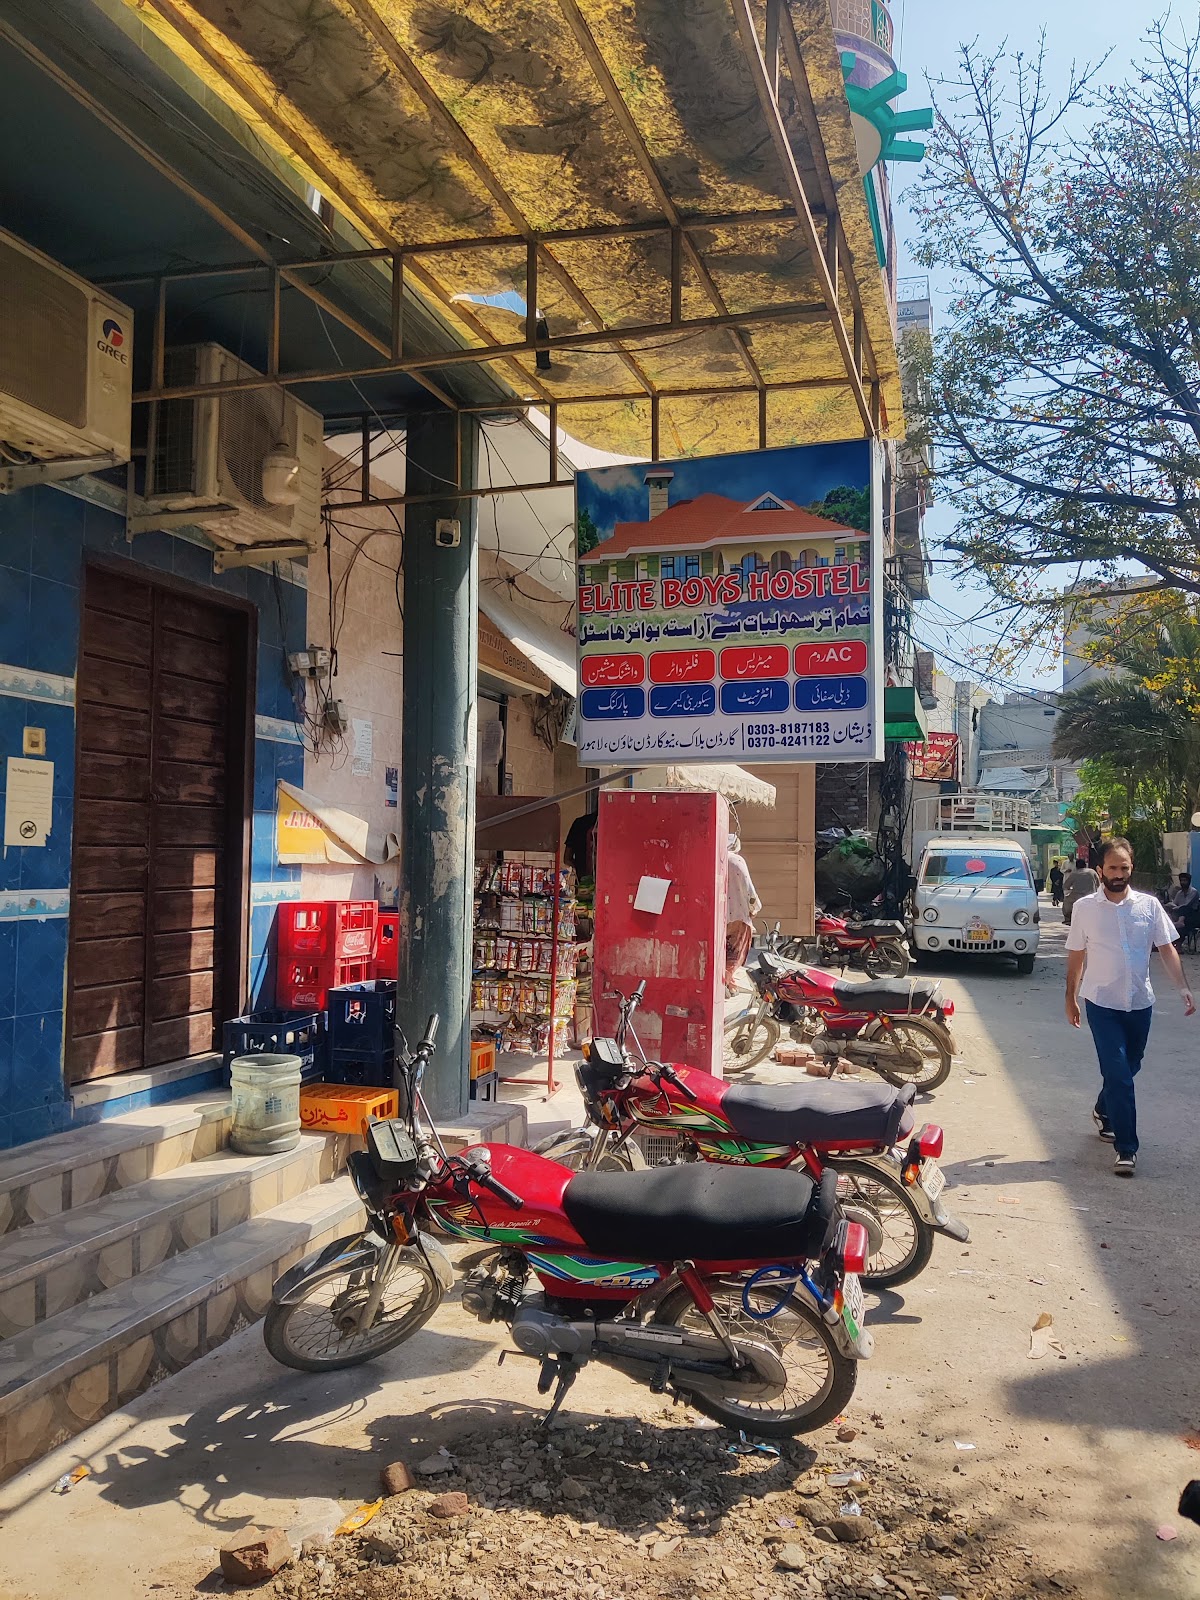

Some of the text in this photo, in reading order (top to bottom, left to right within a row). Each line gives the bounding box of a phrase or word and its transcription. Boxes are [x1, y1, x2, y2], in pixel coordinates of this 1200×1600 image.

[97, 340, 128, 366] GREE
[578, 563, 869, 613] ELITE BOYS HOSTEL
[662, 612, 714, 640] آراستہ
[711, 617, 741, 641] سے
[814, 608, 834, 633] تر
[835, 606, 870, 634] تمام
[624, 621, 660, 644] بوائز
[502, 649, 528, 673] General
[666, 653, 699, 679] فلٹر واٹر
[808, 646, 852, 670] AC روم
[588, 659, 638, 683] واشنگ مشین
[597, 690, 628, 717] پارکنگ
[653, 690, 686, 712] کیمرے
[737, 687, 773, 706] انٹرنیٹ
[811, 682, 851, 705] ڈیلی صفائی
[705, 728, 740, 749] گارڈن
[747, 722, 830, 735] 0303-8187183
[833, 722, 872, 744] ذیشان
[579, 737, 604, 751] لاہور
[633, 730, 667, 752] گارڈن
[662, 733, 676, 748] نیو
[747, 735, 830, 748] 0370-4241122
[301, 1053, 314, 1066] EPSI
[299, 1107, 348, 1127] شیزان
